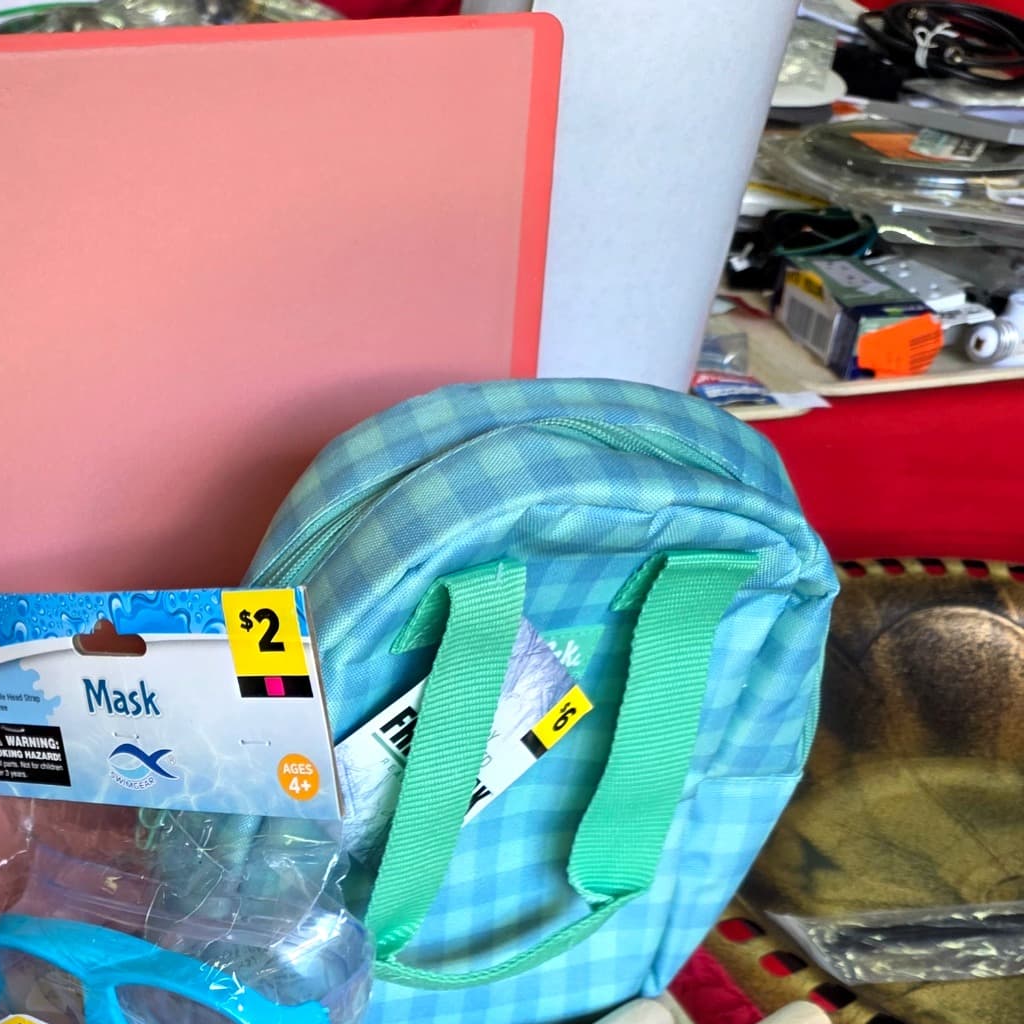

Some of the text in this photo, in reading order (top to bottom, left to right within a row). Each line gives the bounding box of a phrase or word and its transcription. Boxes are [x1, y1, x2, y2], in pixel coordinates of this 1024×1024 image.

[239, 608, 286, 652] $2
[82, 678, 161, 716] Mask
[4, 735, 61, 750] WARNING:
[283, 763, 314, 776] AGES
[289, 777, 312, 794] 4+
